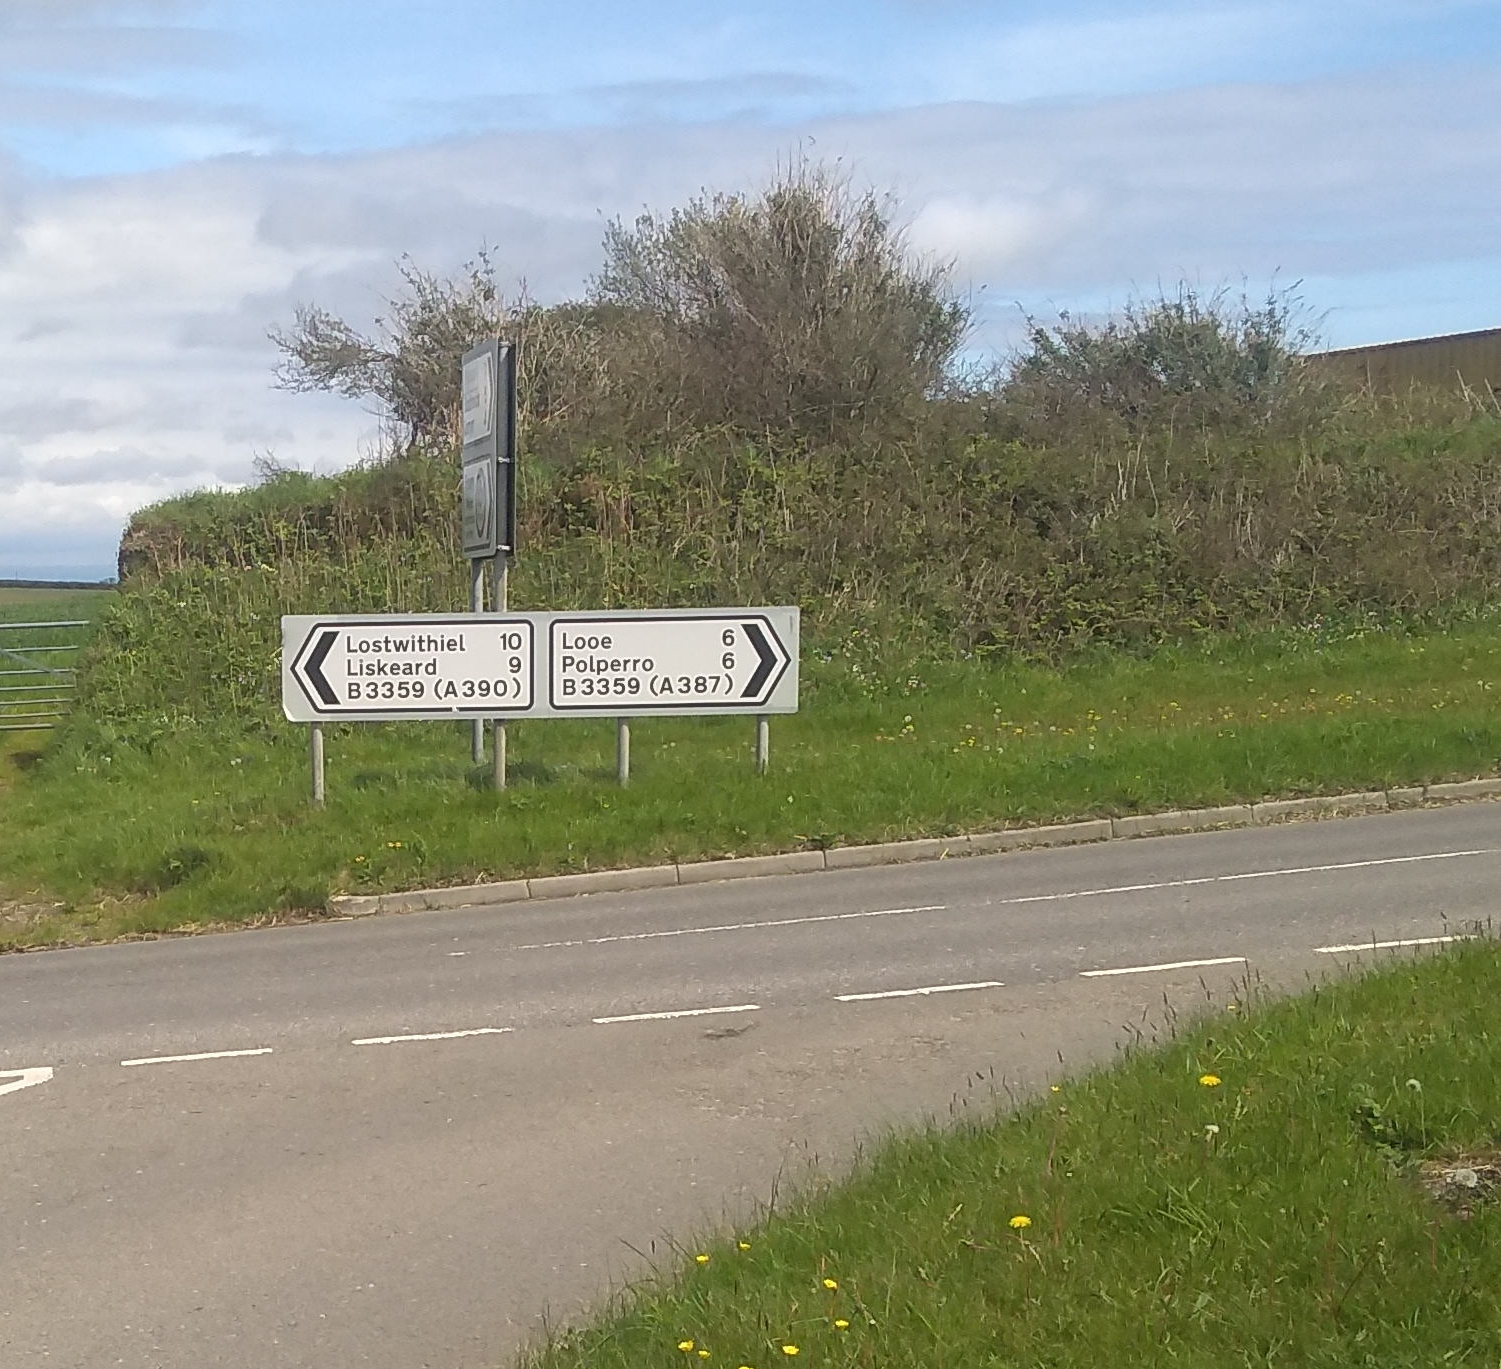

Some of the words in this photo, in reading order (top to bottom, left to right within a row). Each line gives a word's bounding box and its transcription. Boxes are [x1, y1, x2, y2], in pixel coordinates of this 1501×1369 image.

[346, 634, 466, 654] Lostwithiel
[499, 632, 522, 651] 10
[562, 632, 613, 650] Looe
[722, 629, 735, 647] 6
[346, 658, 437, 677] Liskeard
[508, 656, 522, 674] 9
[562, 655, 654, 676] Polperro
[722, 652, 735, 670] 6
[347, 680, 425, 700] B3359
[434, 677, 521, 701] (A390)
[562, 677, 640, 696] B3359
[649, 673, 733, 697] (A387)
